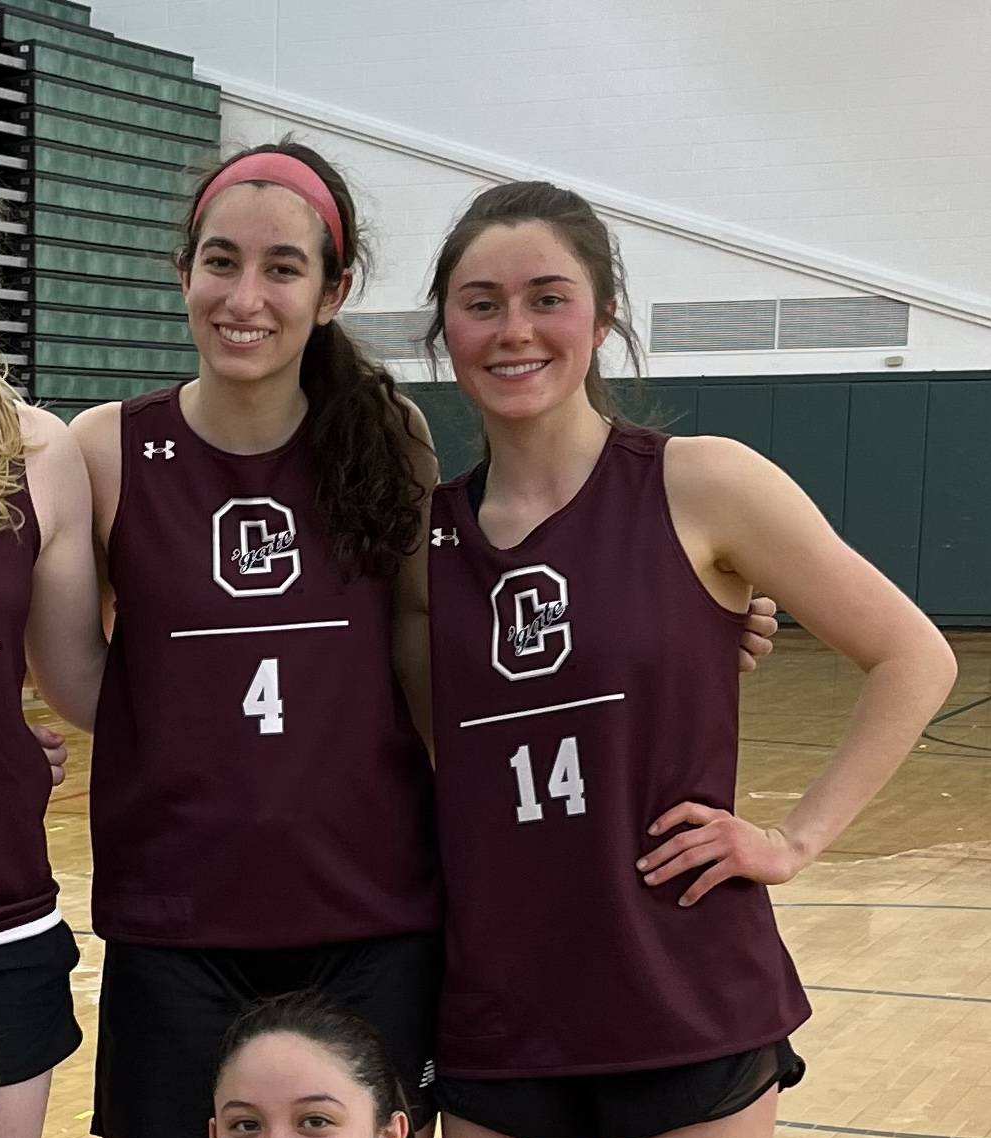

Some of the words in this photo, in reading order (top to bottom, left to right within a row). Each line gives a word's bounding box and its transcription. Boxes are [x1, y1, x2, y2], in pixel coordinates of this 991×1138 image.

[213, 497, 301, 597] C
[490, 564, 572, 681] C
[242, 658, 284, 734] 4
[509, 736, 586, 822] 14
